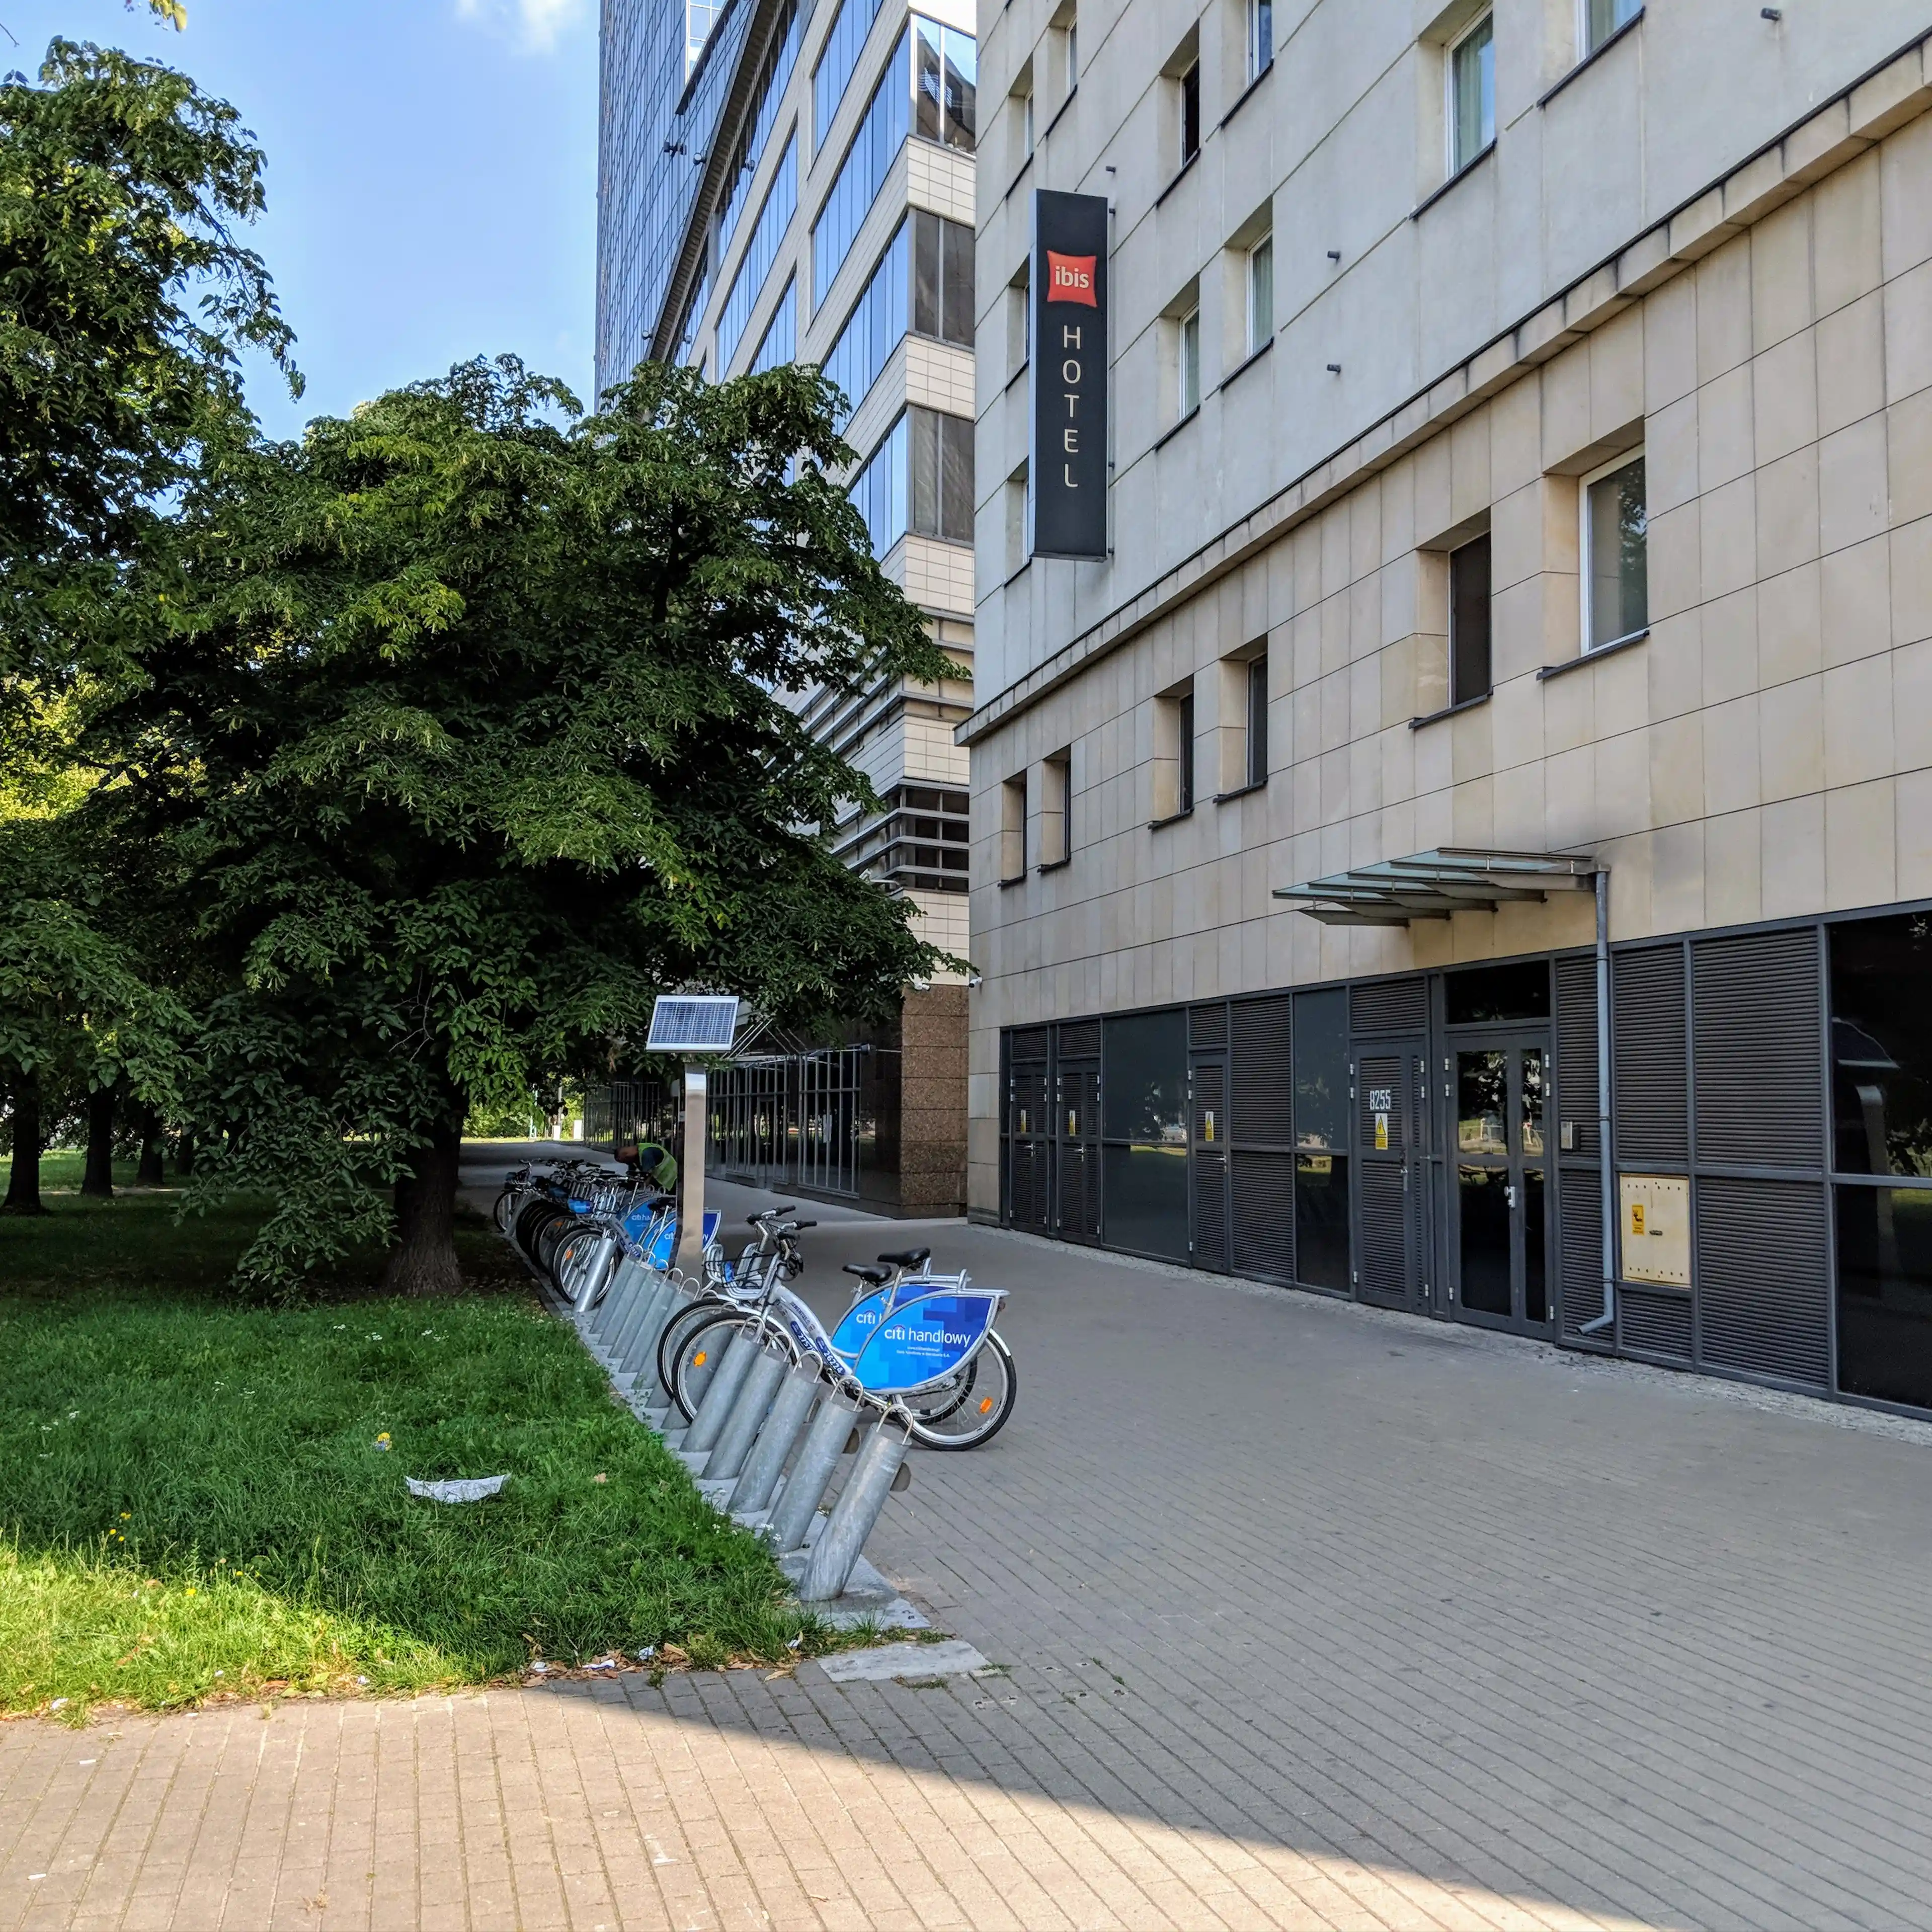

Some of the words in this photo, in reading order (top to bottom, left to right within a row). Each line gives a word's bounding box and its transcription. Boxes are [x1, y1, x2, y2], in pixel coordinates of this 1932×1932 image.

[1055, 265, 1089, 289] ibis
[1063, 325, 1082, 488] HOTEL
[1370, 1089, 1391, 1110] 8255
[856, 1311, 875, 1325] citi
[797, 1333, 816, 1351] 2757
[884, 1326, 905, 1340] citi
[908, 1328, 971, 1348] handlowy
